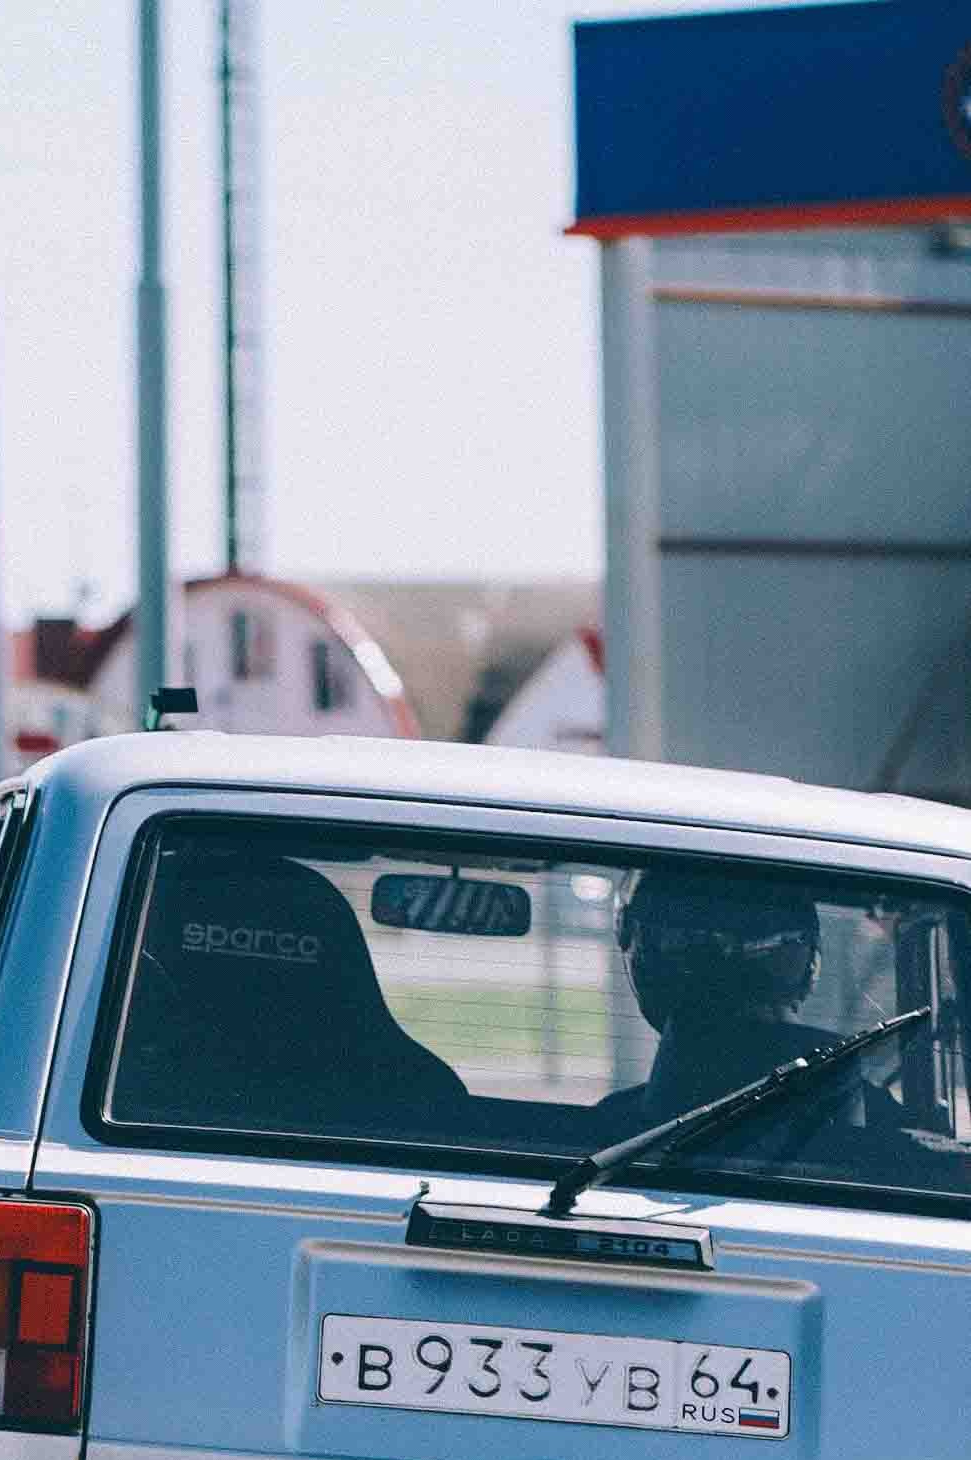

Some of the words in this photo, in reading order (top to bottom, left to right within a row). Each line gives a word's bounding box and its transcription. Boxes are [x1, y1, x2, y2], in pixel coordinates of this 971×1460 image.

[182, 922, 320, 957] sparco
[461, 1224, 546, 1249] LADA
[690, 1353, 758, 1404] 64
[682, 1403, 735, 1424] RUS
